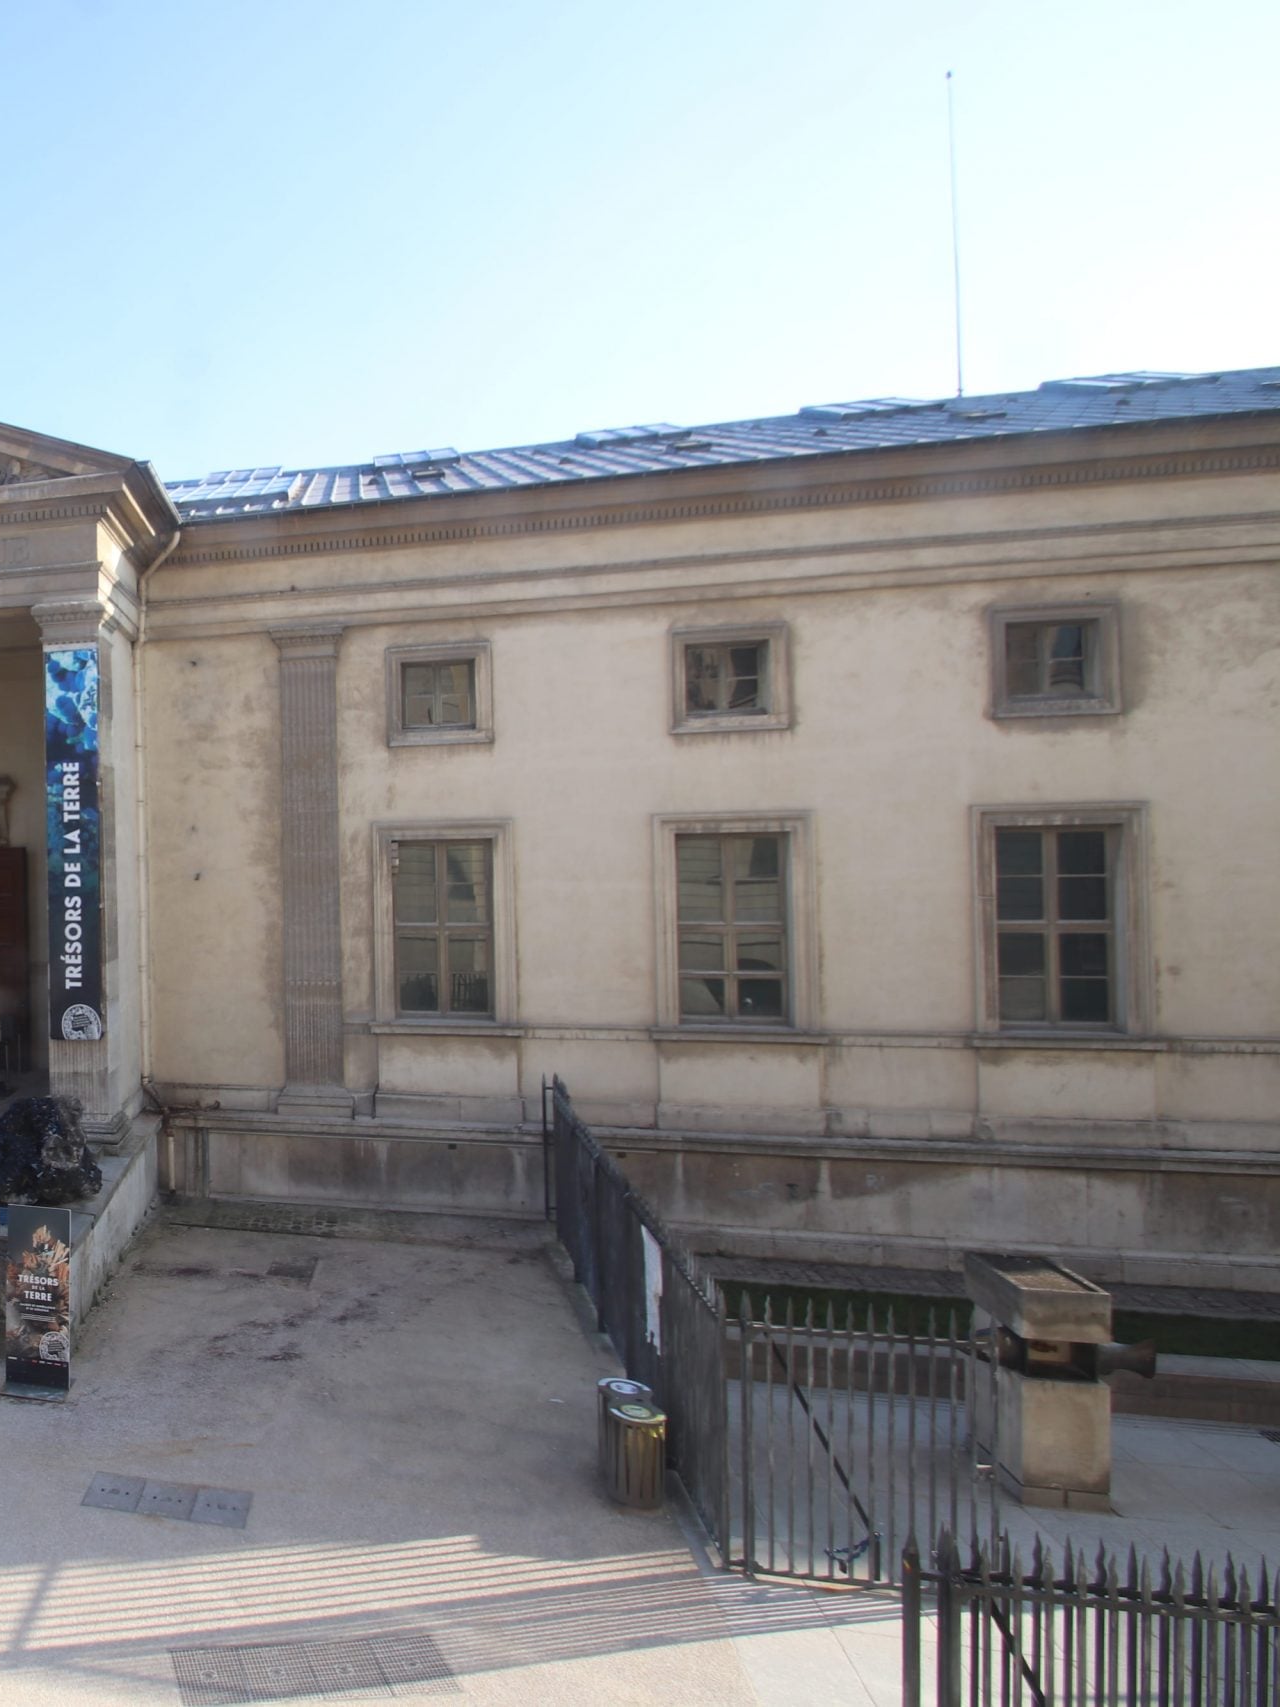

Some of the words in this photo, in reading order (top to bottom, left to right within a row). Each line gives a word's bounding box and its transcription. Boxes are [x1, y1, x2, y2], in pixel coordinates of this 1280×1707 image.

[62, 762, 81, 823] TERRE
[62, 828, 81, 854] LA
[63, 862, 82, 888] DE
[60, 895, 83, 990] TRÉSORS
[18, 1274, 59, 1286] TRÉSORS
[24, 1290, 52, 1302] TERRE
